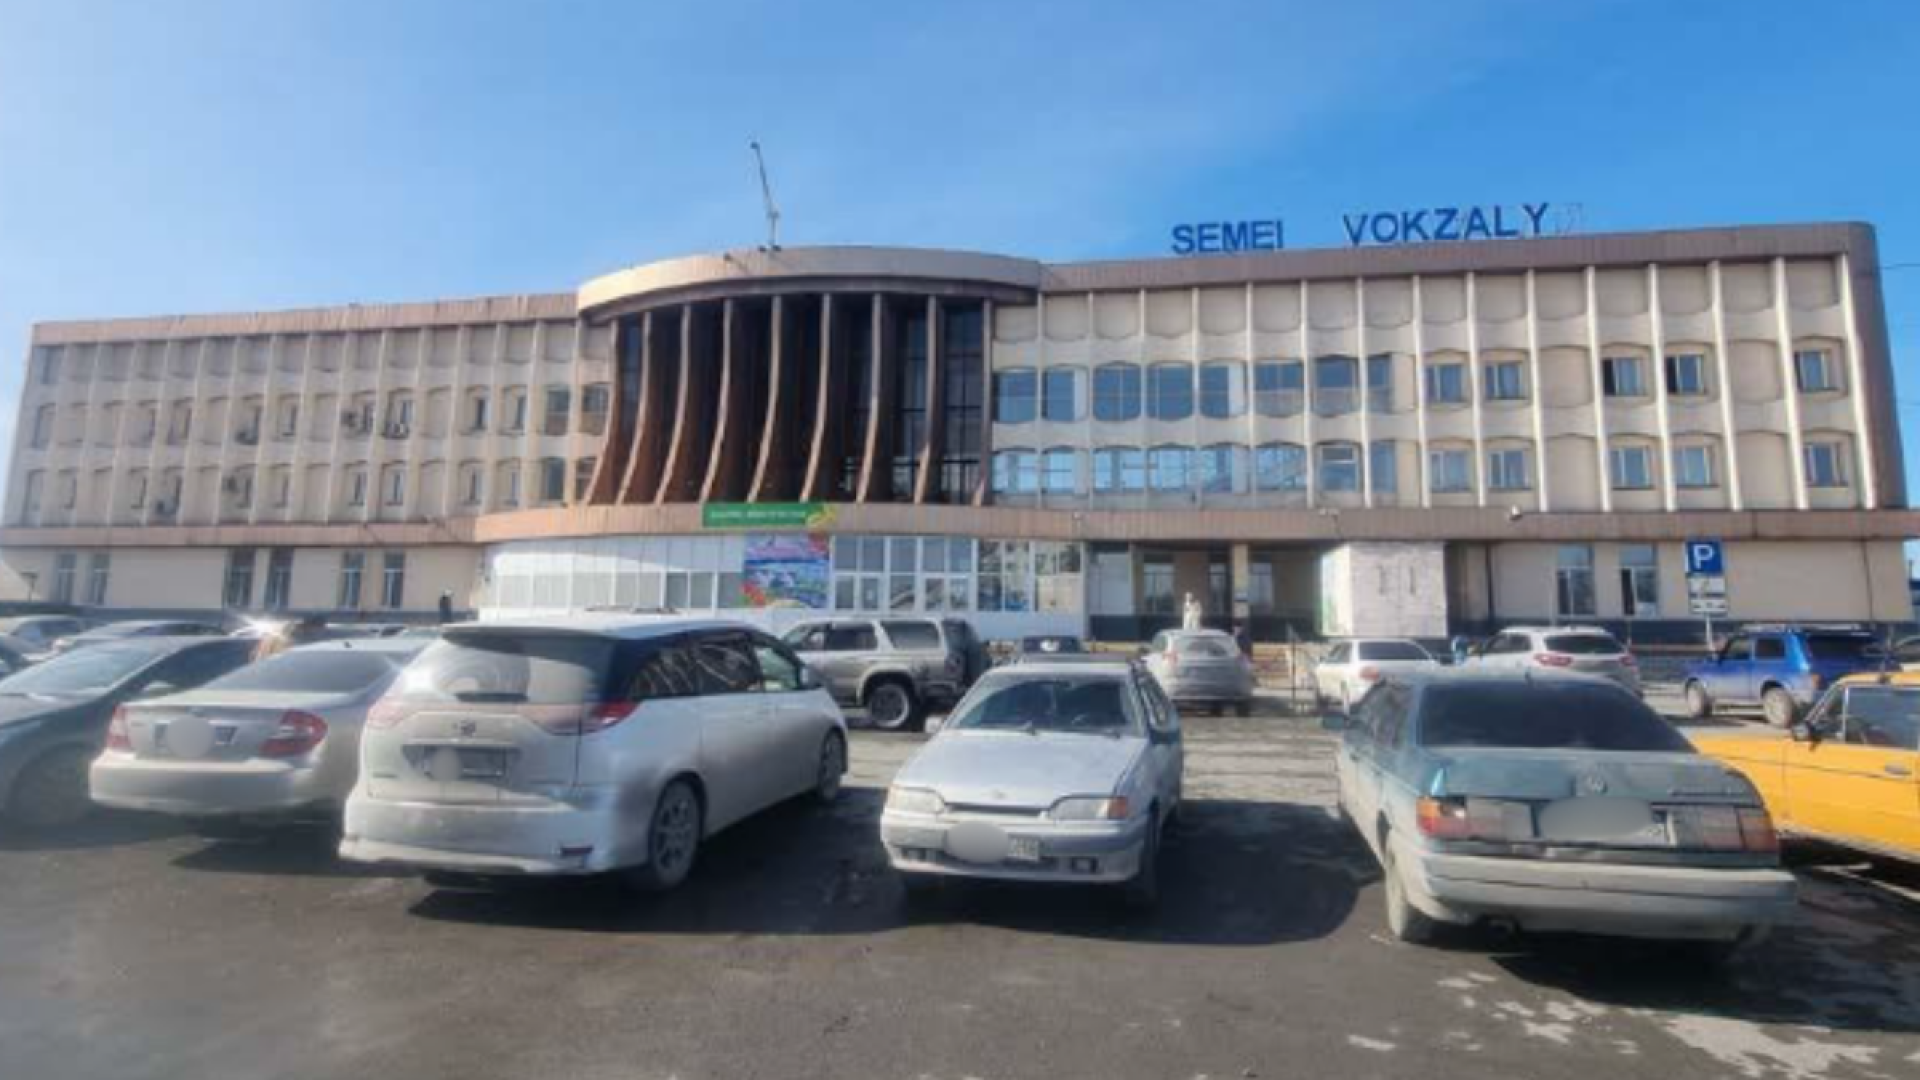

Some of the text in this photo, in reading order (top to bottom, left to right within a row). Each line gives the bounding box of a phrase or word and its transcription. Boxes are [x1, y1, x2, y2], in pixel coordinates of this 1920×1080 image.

[1171, 203, 1549, 254] SEMEI VOKZALY
[1693, 544, 1713, 569] P
